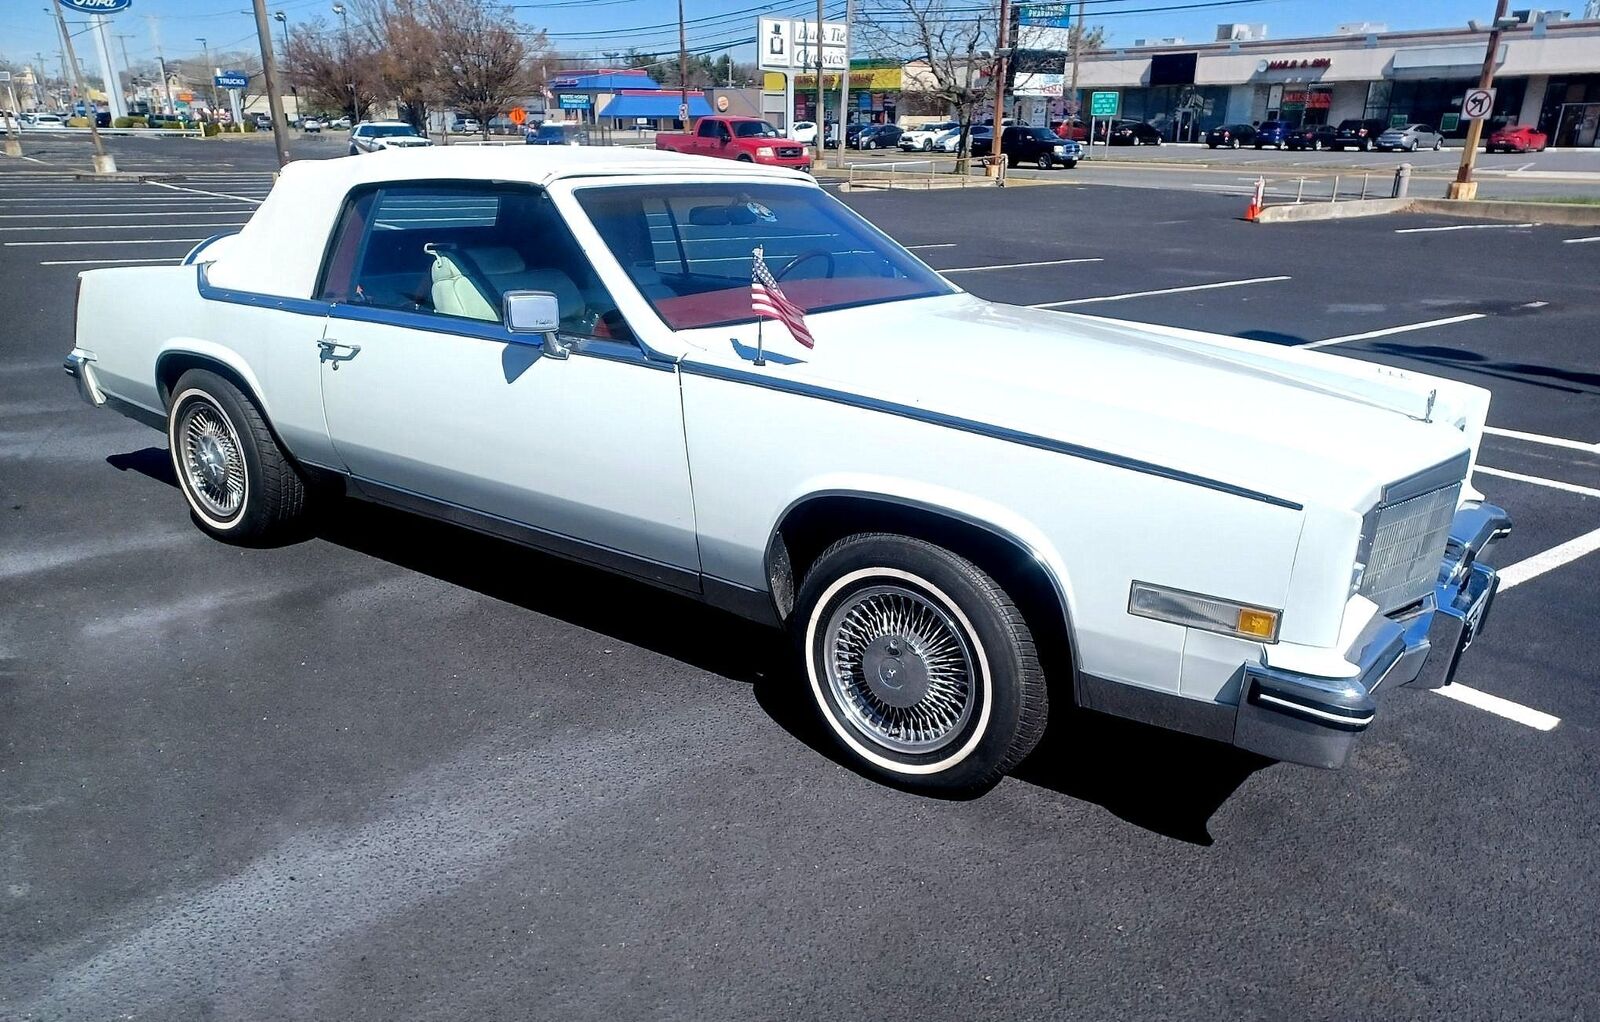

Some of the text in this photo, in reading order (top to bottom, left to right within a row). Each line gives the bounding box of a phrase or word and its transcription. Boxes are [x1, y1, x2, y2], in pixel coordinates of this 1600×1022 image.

[798, 26, 846, 42] Blak Tie
[796, 49, 845, 65] Clasics
